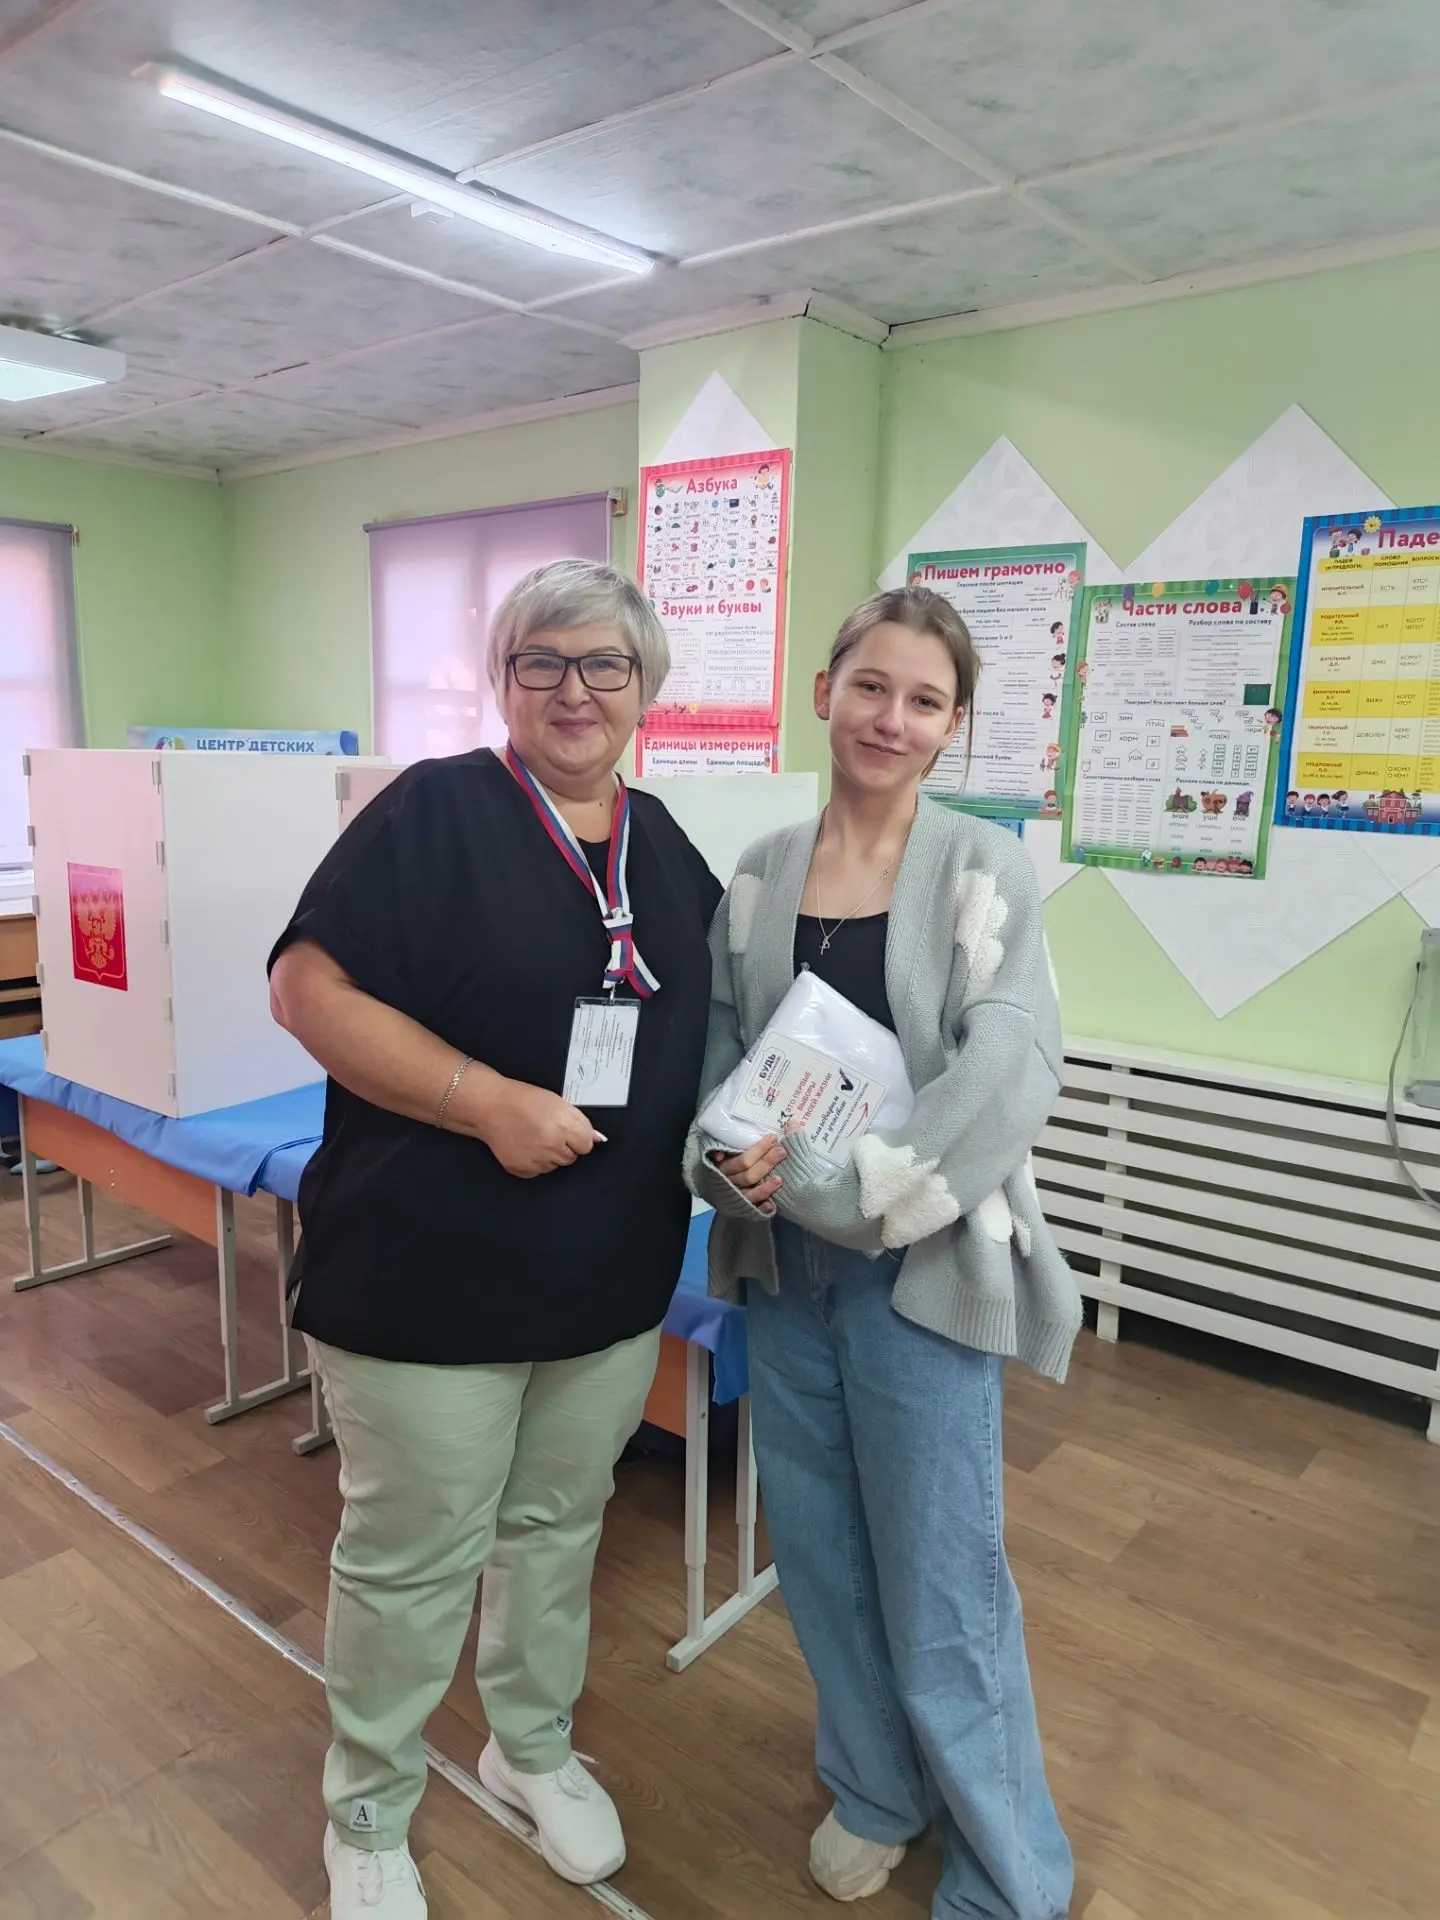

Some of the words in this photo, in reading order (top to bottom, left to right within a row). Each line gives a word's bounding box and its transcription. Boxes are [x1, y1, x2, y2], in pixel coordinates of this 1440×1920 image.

[686, 477, 738, 495] Азбука
[1379, 528, 1440, 548] Паде
[924, 564, 979, 580] Пишем
[984, 562, 1066, 580] грамотно
[661, 601, 702, 619] Звуки
[706, 605, 715, 614] и
[718, 599, 762, 617] буквы
[1122, 600, 1177, 616] Части
[1182, 600, 1242, 615] слова
[196, 739, 245, 751] ЦЕНТР
[248, 740, 315, 752] ДЕТСКИХ
[645, 737, 697, 751] Единицы
[700, 740, 771, 754] измерения
[759, 1054, 776, 1079] БУДЬ
[785, 1099, 795, 1113] ЭТО
[794, 1070, 812, 1099] ПЕРВЫЕ
[797, 1081, 817, 1111] ВЫБОРЫ
[803, 1098, 819, 1121] ТВОЕЙ
[816, 1072, 833, 1099] ЖИЗНИ
[811, 1096, 840, 1144] Благодарим
[356, 1804, 368, 1821] A
